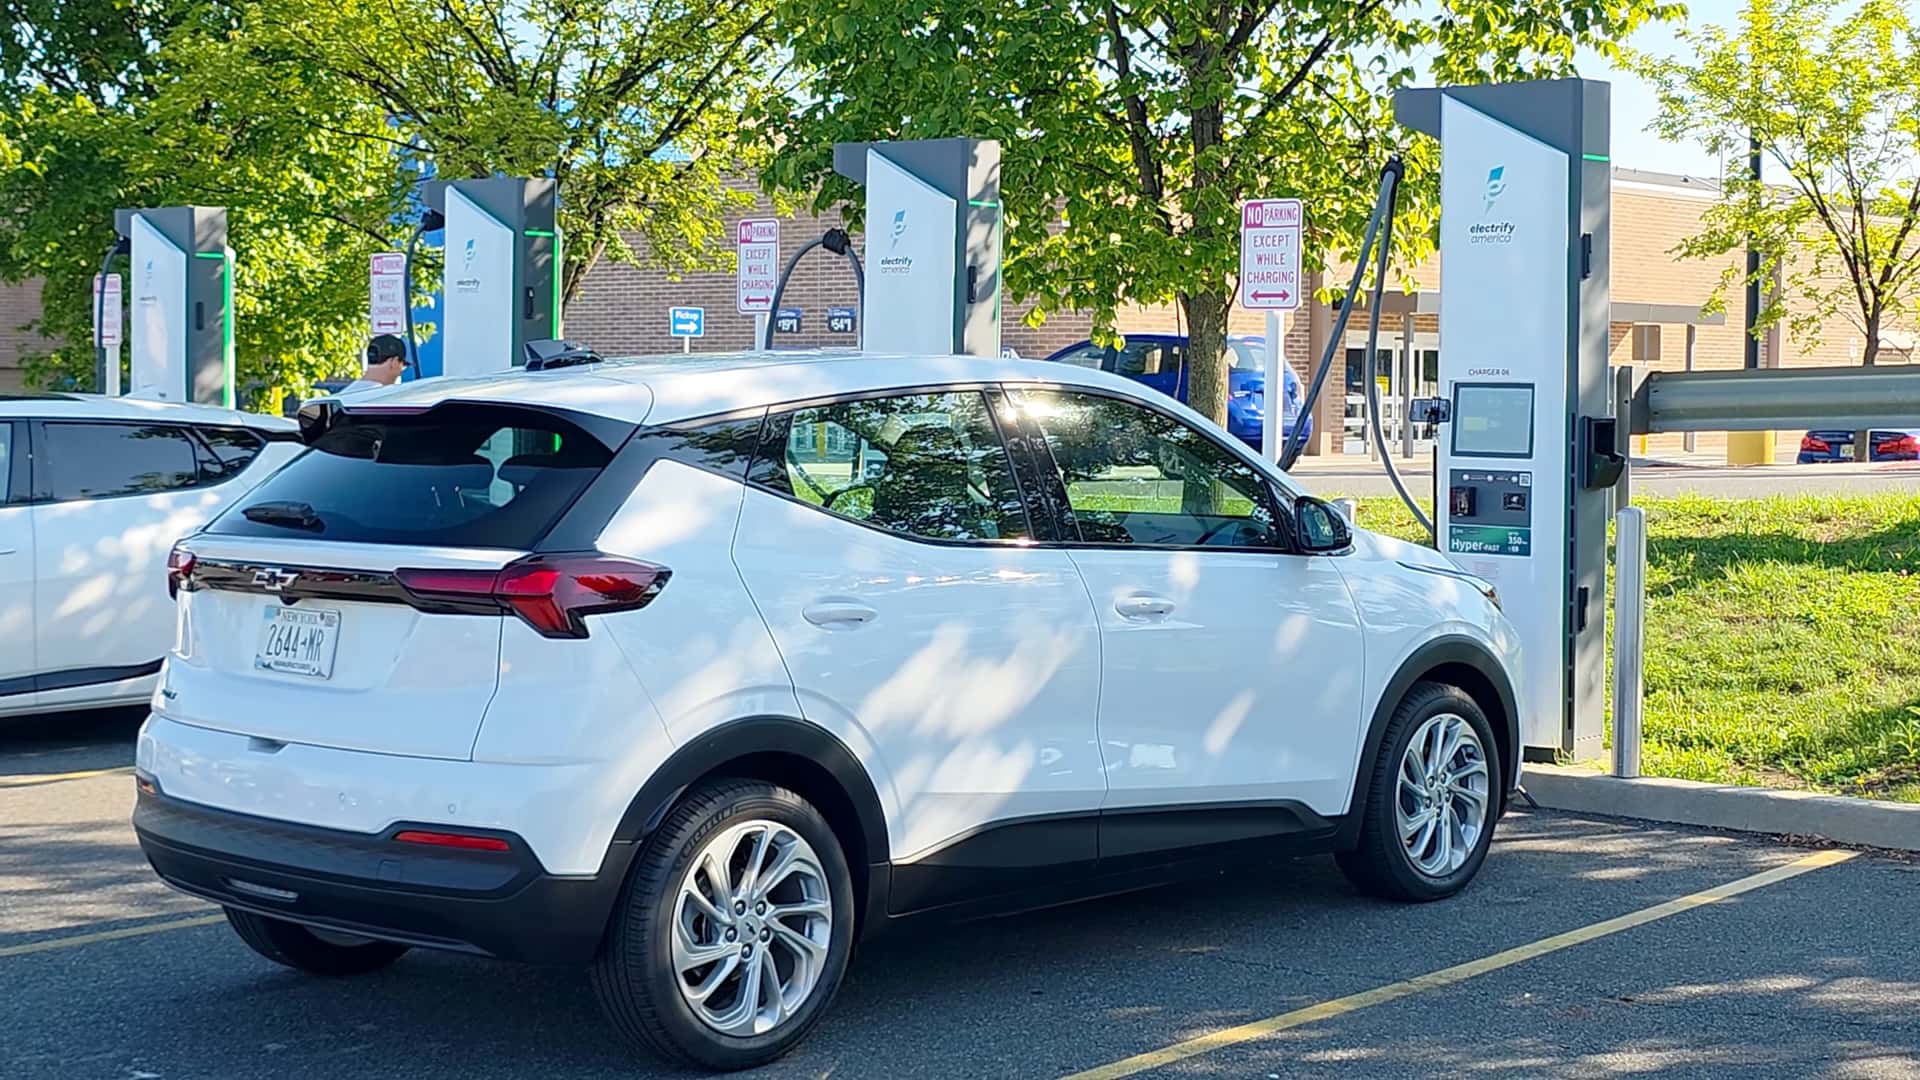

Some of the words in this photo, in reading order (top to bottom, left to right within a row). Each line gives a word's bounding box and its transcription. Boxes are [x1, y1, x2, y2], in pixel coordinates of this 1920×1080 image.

[1247, 207, 1261, 224] NO
[1264, 207, 1297, 222] PARKING
[741, 224, 752, 240] NO
[753, 225, 775, 237] PARKING
[1470, 222, 1515, 234] electrify
[1253, 234, 1290, 248] EXCEPT
[1470, 234, 1512, 243] america
[745, 249, 770, 260] EXCEPT
[1256, 252, 1286, 266] WHILE
[881, 256, 912, 267] electrify
[748, 264, 768, 275] WHILE
[1247, 271, 1295, 284] CHARGING
[742, 280, 774, 290] CHARGING
[675, 310, 699, 321] Pickup
[1468, 368, 1500, 376] CHARGER
[282, 611, 299, 622] NEW
